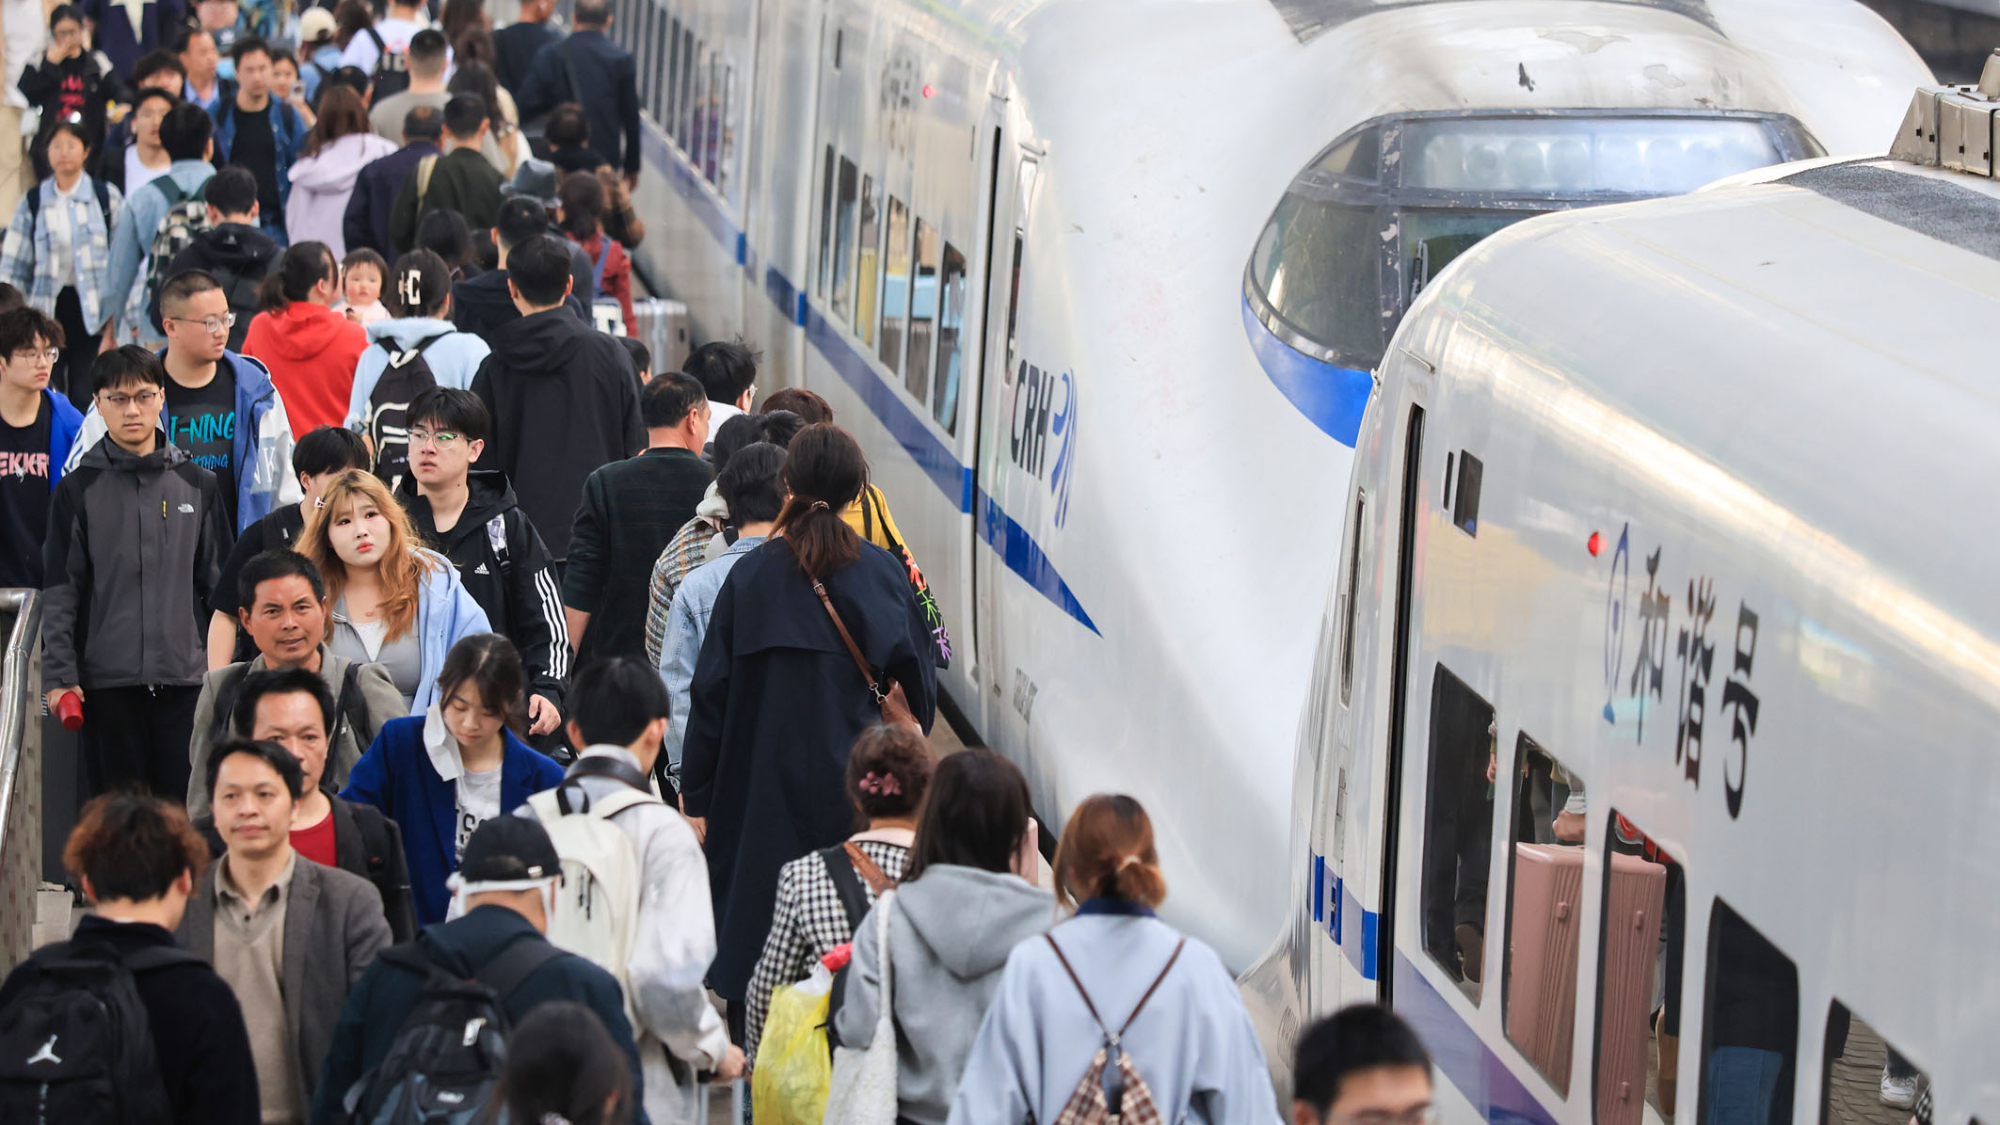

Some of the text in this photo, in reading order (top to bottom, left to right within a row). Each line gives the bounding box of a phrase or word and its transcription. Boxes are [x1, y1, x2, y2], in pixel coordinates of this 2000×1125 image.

[0, 451, 50, 479] EKKR
[1011, 359, 1054, 481] CRH
[1631, 544, 1760, 821] 和谐号
